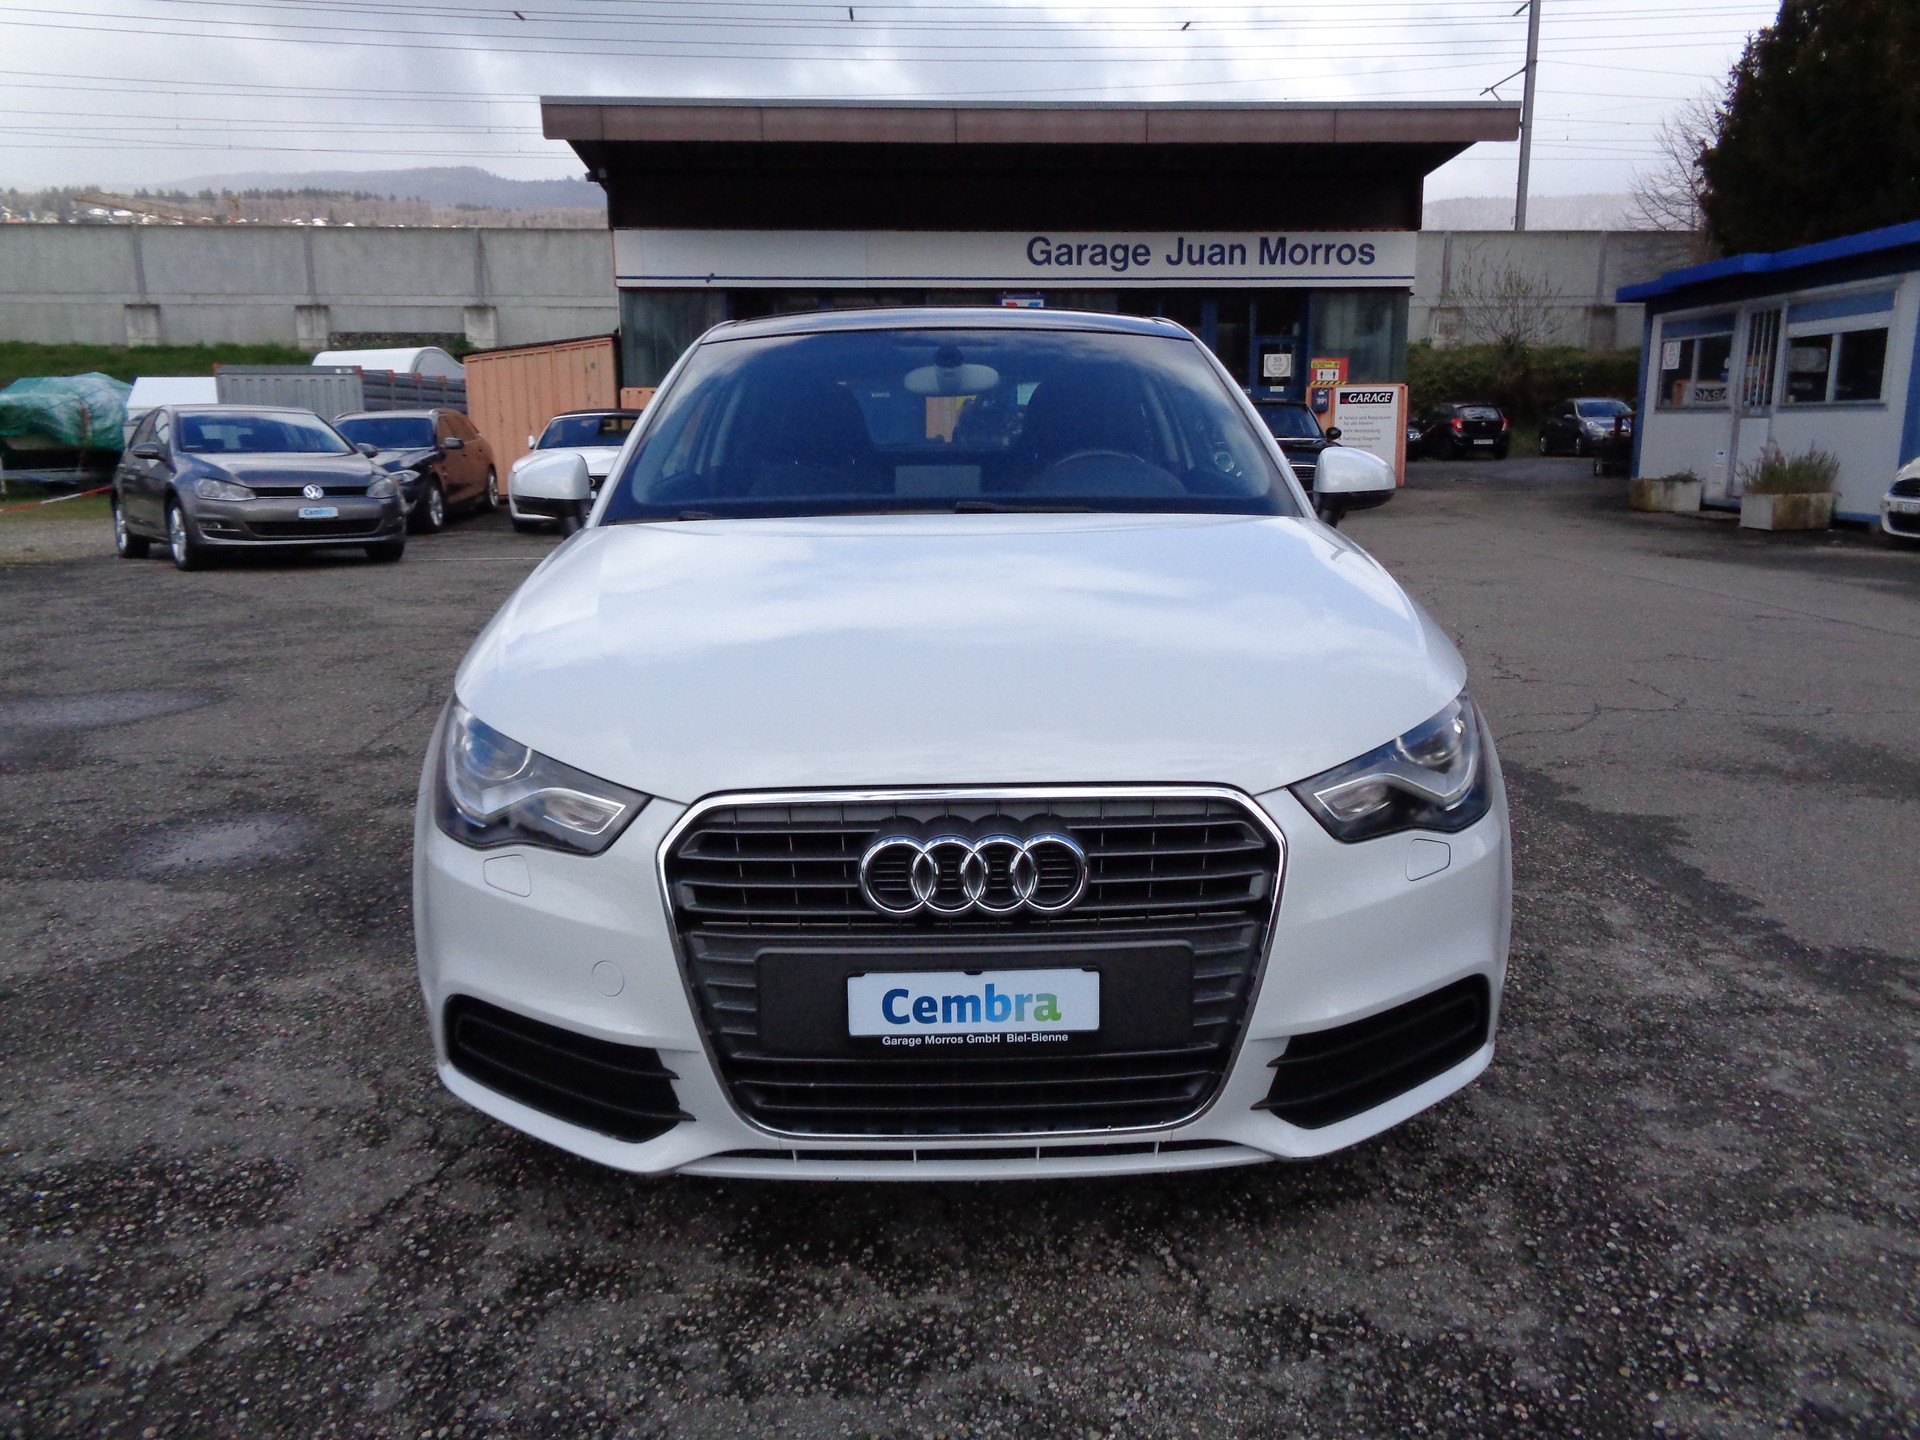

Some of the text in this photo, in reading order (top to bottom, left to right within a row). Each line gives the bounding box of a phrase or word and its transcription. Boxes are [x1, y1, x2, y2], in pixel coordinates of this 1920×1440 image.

[1026, 236, 1376, 272] Garage Juan Morros
[1348, 393, 1392, 403] GARAGE
[881, 983, 1062, 1025] Cembra
[882, 1032, 1069, 1047] Garage Morros GmbH Biel-Bienne
